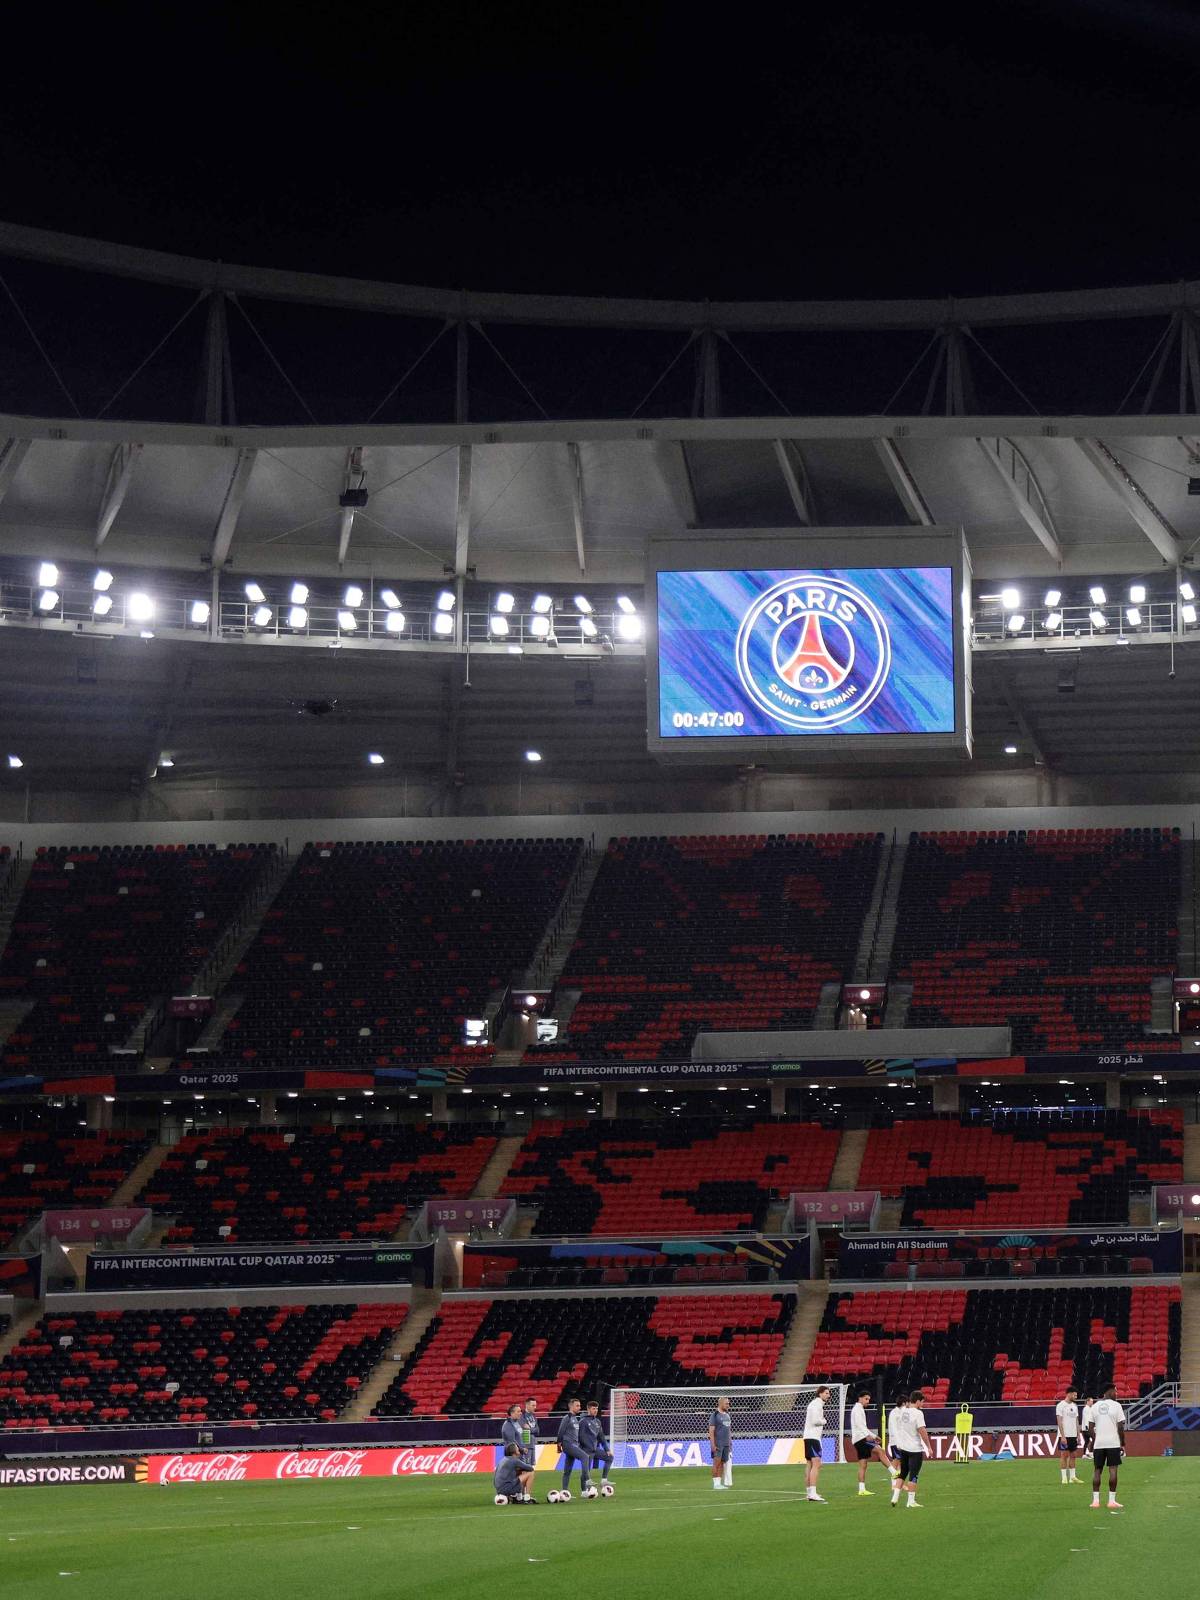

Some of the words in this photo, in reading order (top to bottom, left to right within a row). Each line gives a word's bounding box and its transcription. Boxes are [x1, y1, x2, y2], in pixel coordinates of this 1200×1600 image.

[764, 588, 858, 624] PARIS
[768, 683, 802, 708] SAINT
[810, 685, 857, 711] GERMAIN
[672, 711, 744, 728] 00:47:00
[1098, 1056, 1121, 1064] 2025
[1124, 1055, 1143, 1066] قطر
[543, 1068, 564, 1076] FIFA
[566, 1066, 659, 1076] INTERCONTINENTAL
[660, 1065, 680, 1073] CUP
[681, 1065, 713, 1074] QATAR
[772, 1063, 800, 1071] aramco
[180, 1075, 208, 1085] Qatar
[211, 1074, 239, 1083] 2025
[1167, 1195, 1184, 1205] 131
[803, 1202, 823, 1213] 132
[848, 1202, 865, 1212] 131
[438, 1210, 457, 1220] 133
[481, 1209, 501, 1219] 132
[60, 1220, 80, 1230] 134
[847, 1241, 879, 1250] Ahmad
[881, 1241, 895, 1249] bin
[897, 1241, 909, 1249] Ali
[910, 1240, 948, 1249] Stadium
[94, 1260, 119, 1270] FIFA
[121, 1257, 236, 1269] INTERCONTINENTAL
[239, 1255, 263, 1266] CUP
[264, 1256, 304, 1267] QATAR
[376, 1253, 412, 1263] aramco
[627, 1442, 704, 1467] VISA
[0, 1465, 125, 1483] IFASTORE.COM
